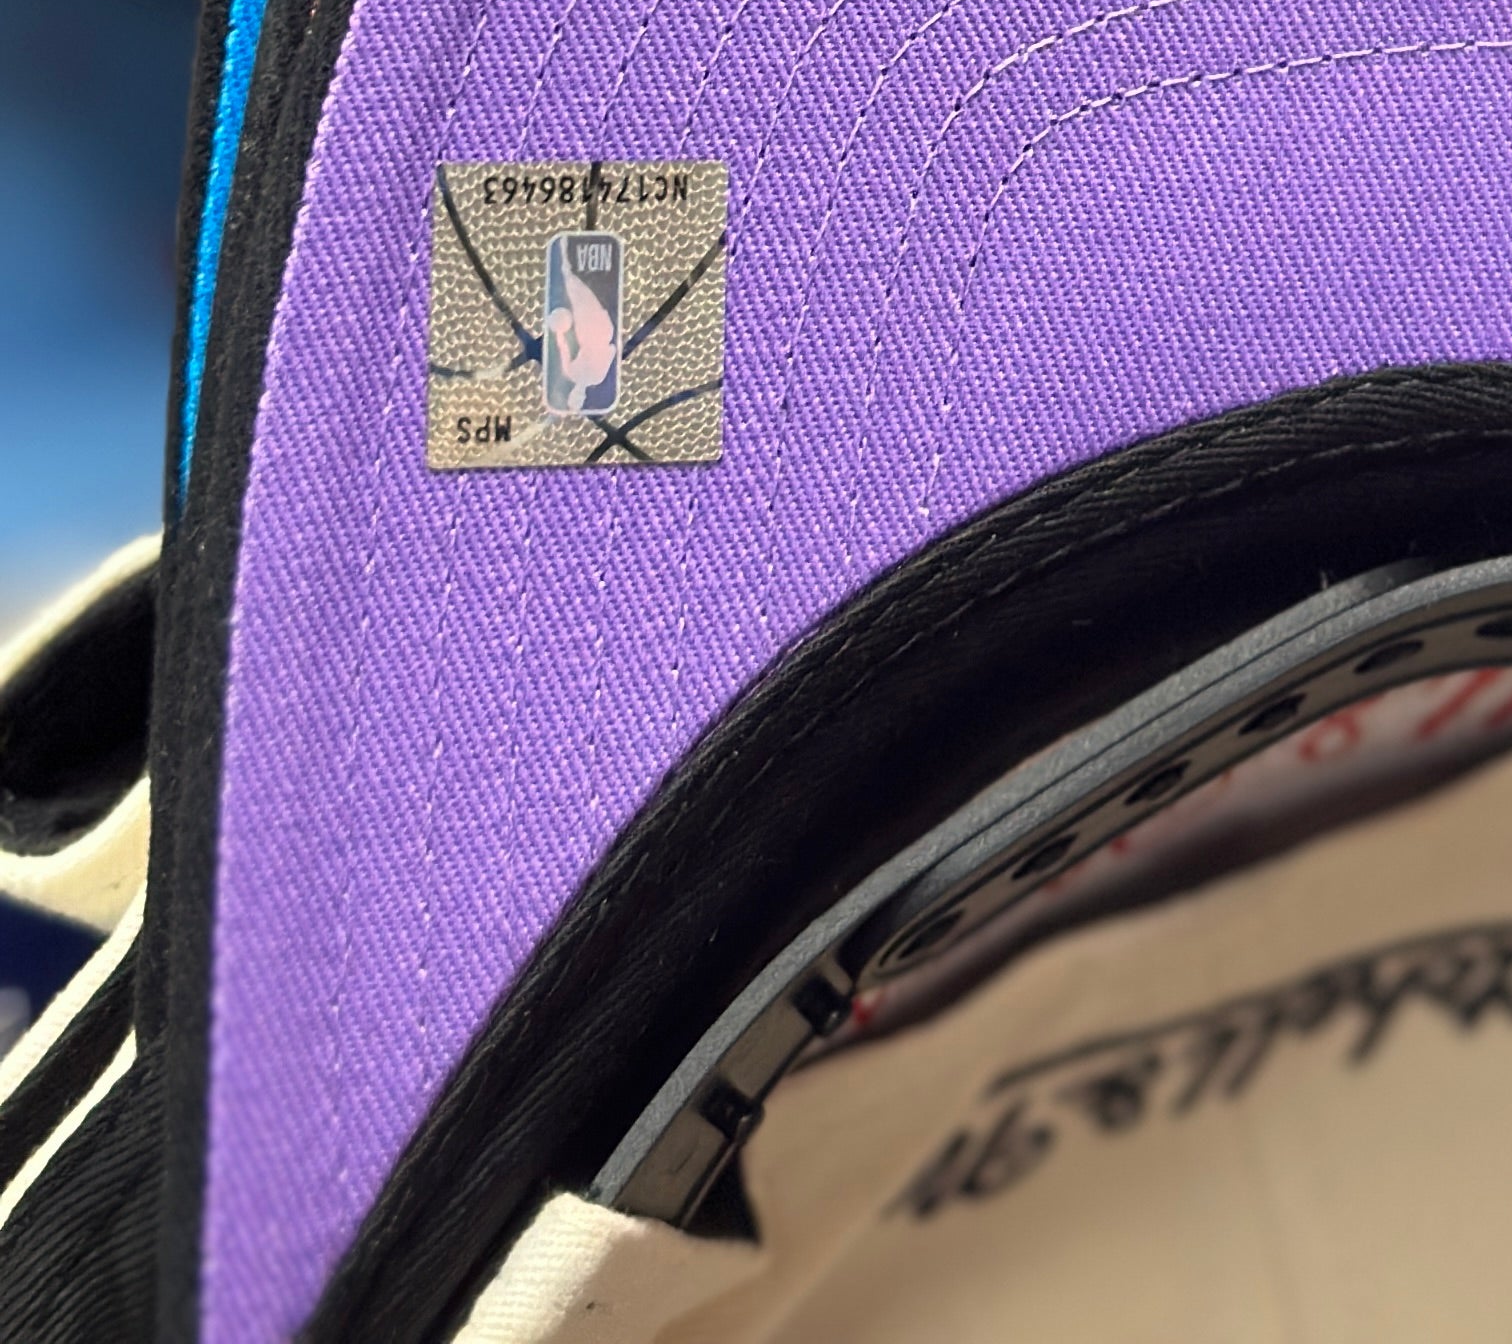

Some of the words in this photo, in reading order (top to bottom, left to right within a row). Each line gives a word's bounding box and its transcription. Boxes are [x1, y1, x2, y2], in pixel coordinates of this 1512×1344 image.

[482, 174, 688, 205] NC174186463
[576, 244, 612, 273] NBA
[456, 416, 512, 444] MPS
